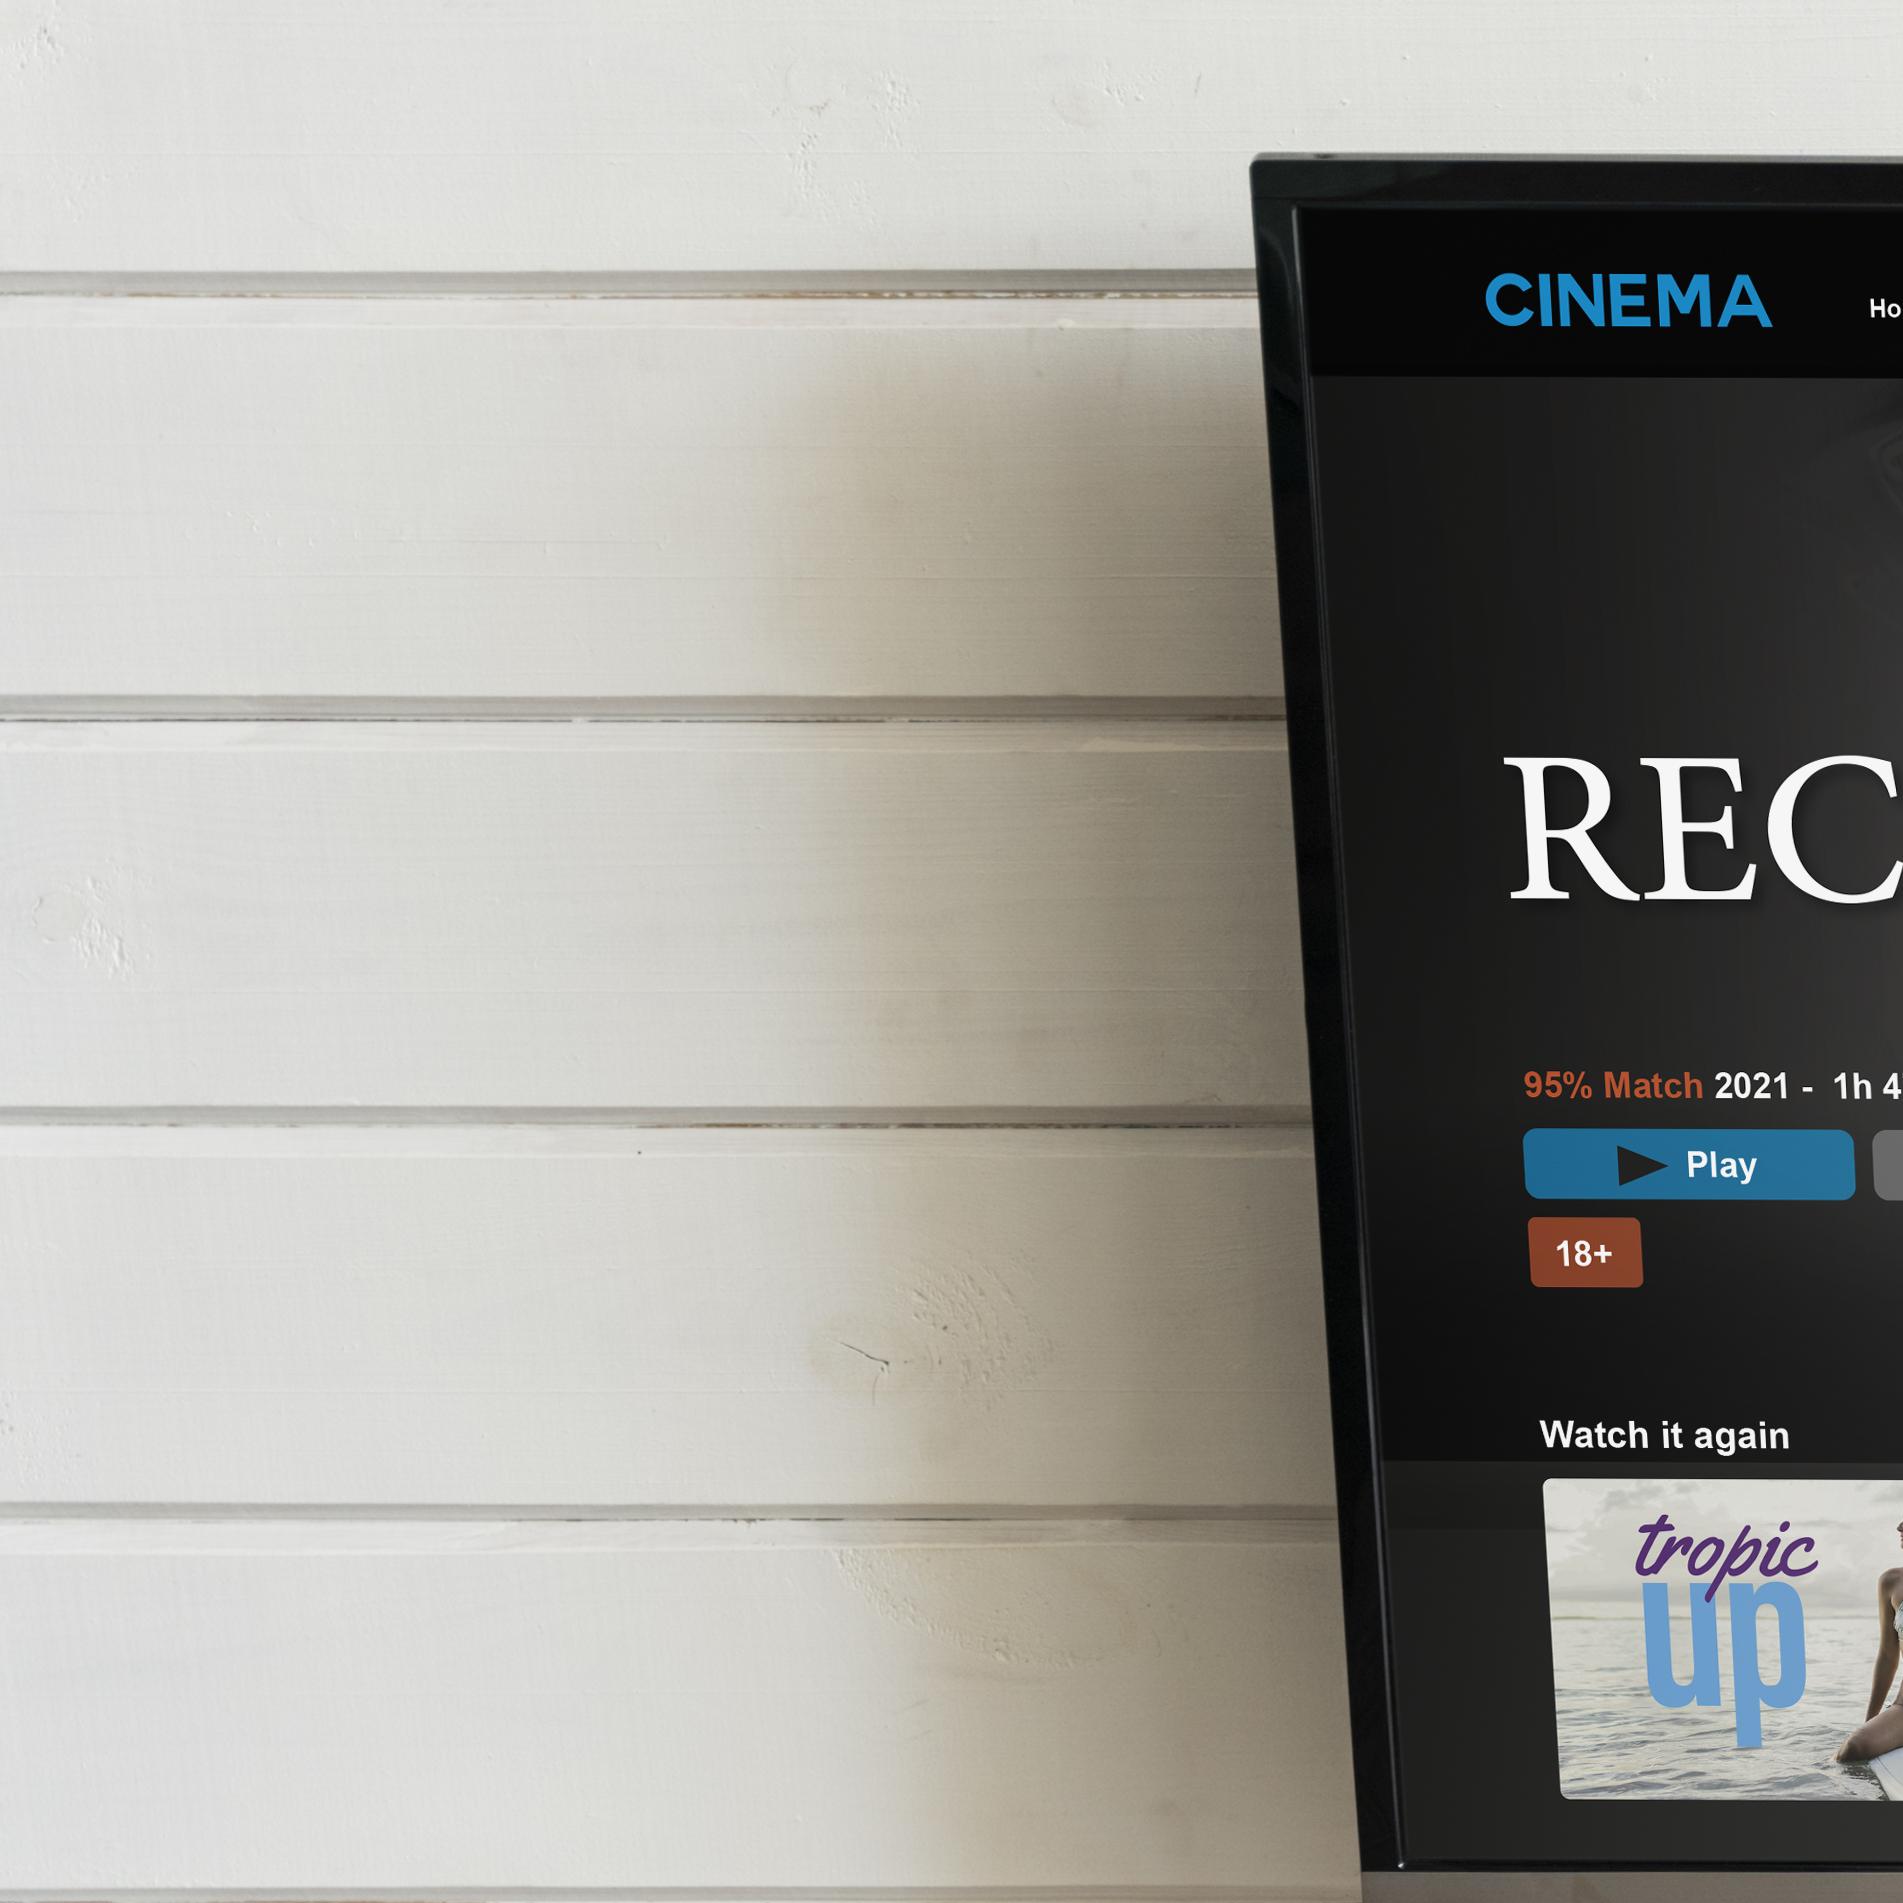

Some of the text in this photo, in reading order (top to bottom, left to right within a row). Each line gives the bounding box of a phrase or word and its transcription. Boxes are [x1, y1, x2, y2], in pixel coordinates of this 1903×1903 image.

[1484, 272, 1773, 328] CINEMA
[1524, 1071, 1593, 1100] 95%
[1604, 1071, 1703, 1100] Match
[1714, 1071, 1787, 1100] 2021
[1833, 1071, 1873, 1100] 1h
[1687, 1150, 1757, 1185] Play
[1556, 1240, 1612, 1267] 18+
[1539, 1419, 1790, 1457] Watch it again
[1635, 1514, 1819, 1604] tropic
[1642, 1581, 1806, 1749] up
